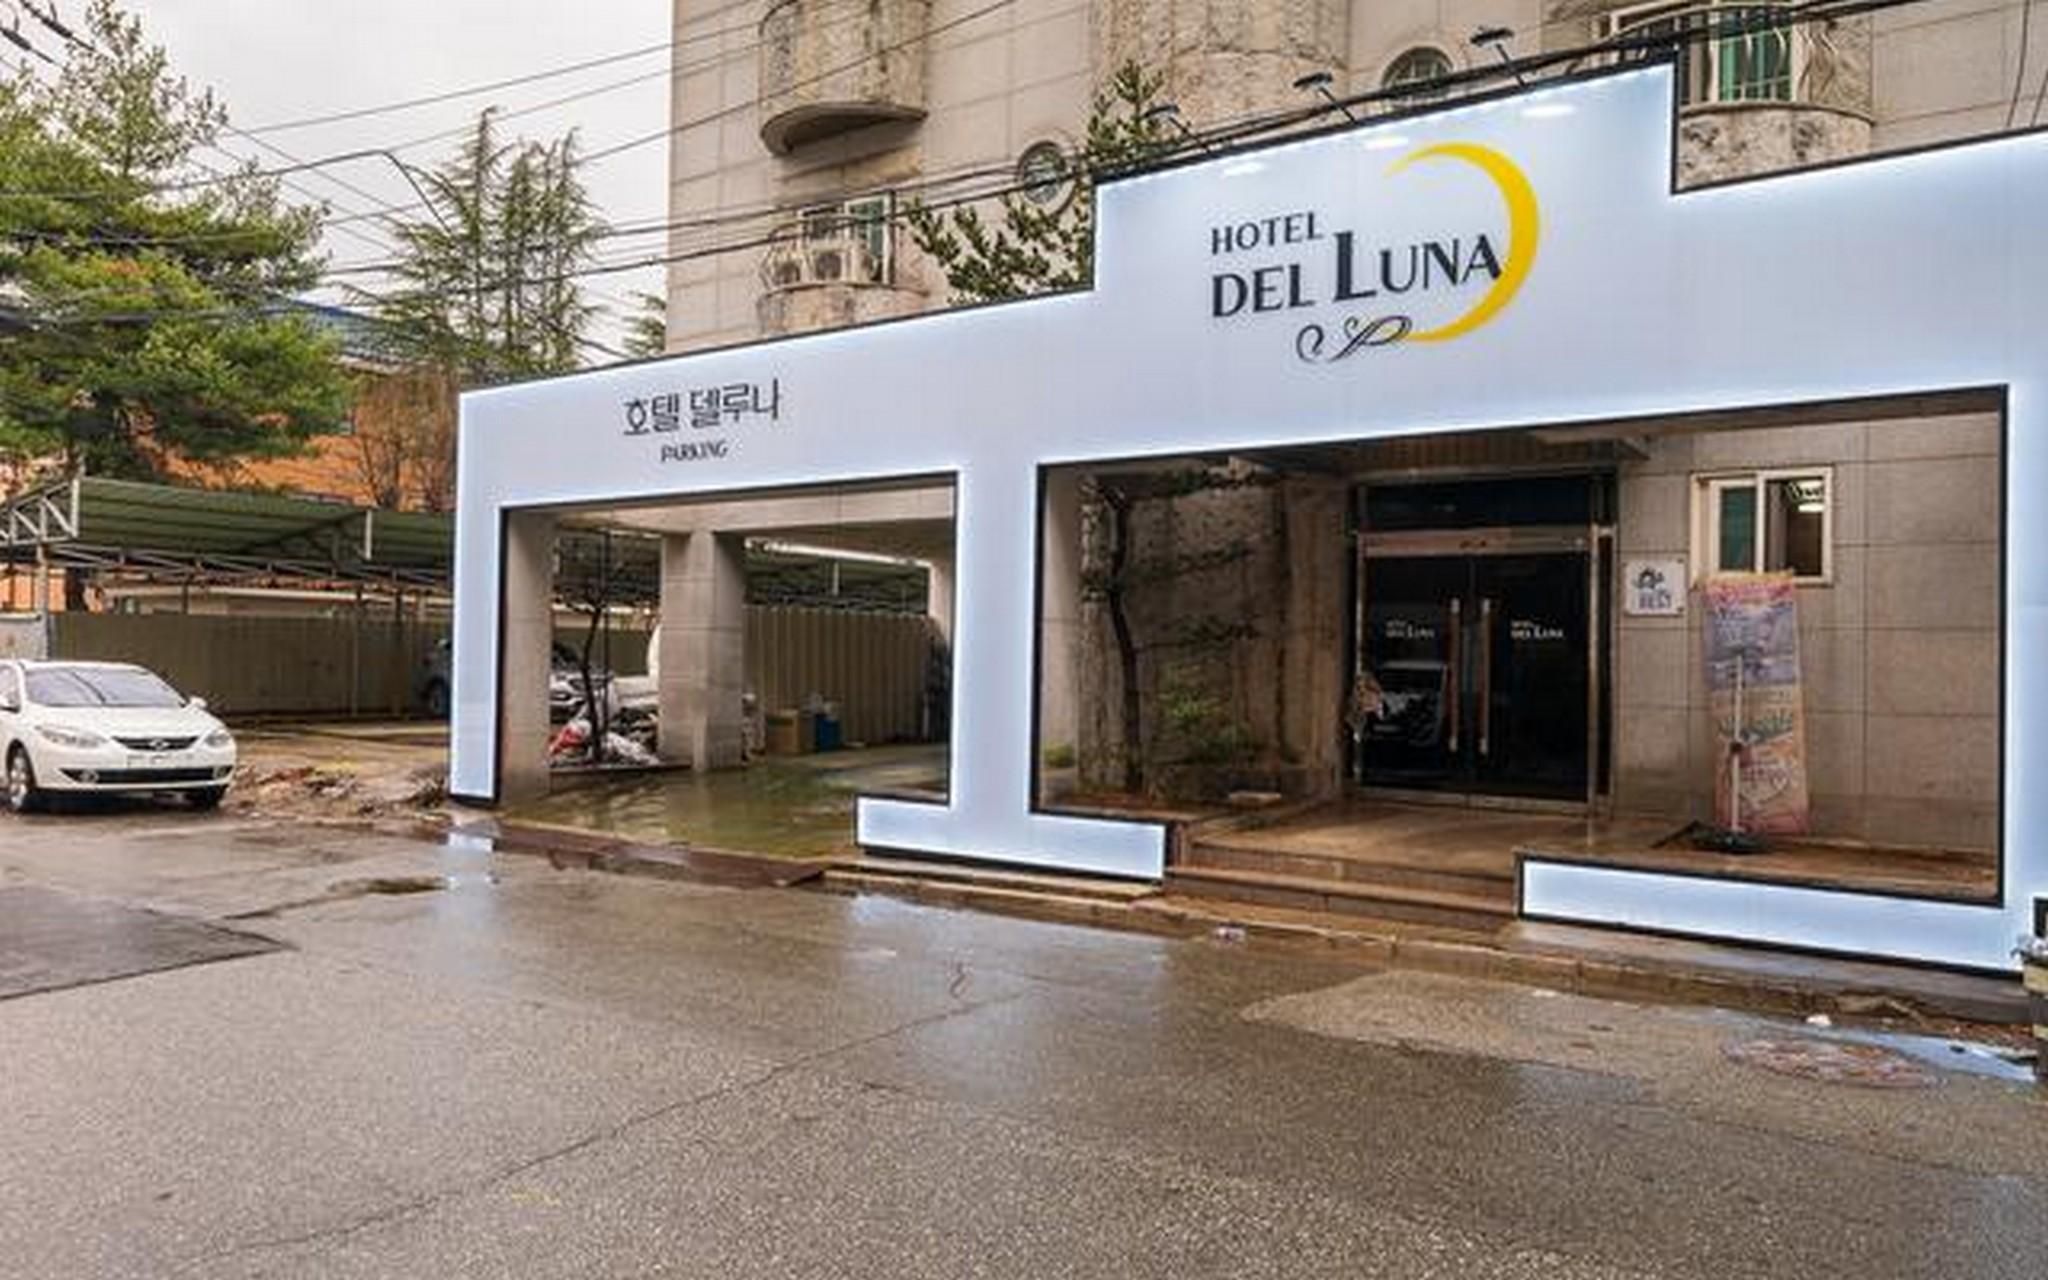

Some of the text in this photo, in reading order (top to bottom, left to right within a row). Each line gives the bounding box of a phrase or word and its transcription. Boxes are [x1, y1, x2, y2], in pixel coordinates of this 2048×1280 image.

[1211, 211, 1323, 254] HOTEL
[1211, 230, 1502, 318] DEL LUNA
[623, 378, 779, 436] 호텔 델루나
[661, 439, 729, 463] PARKING
